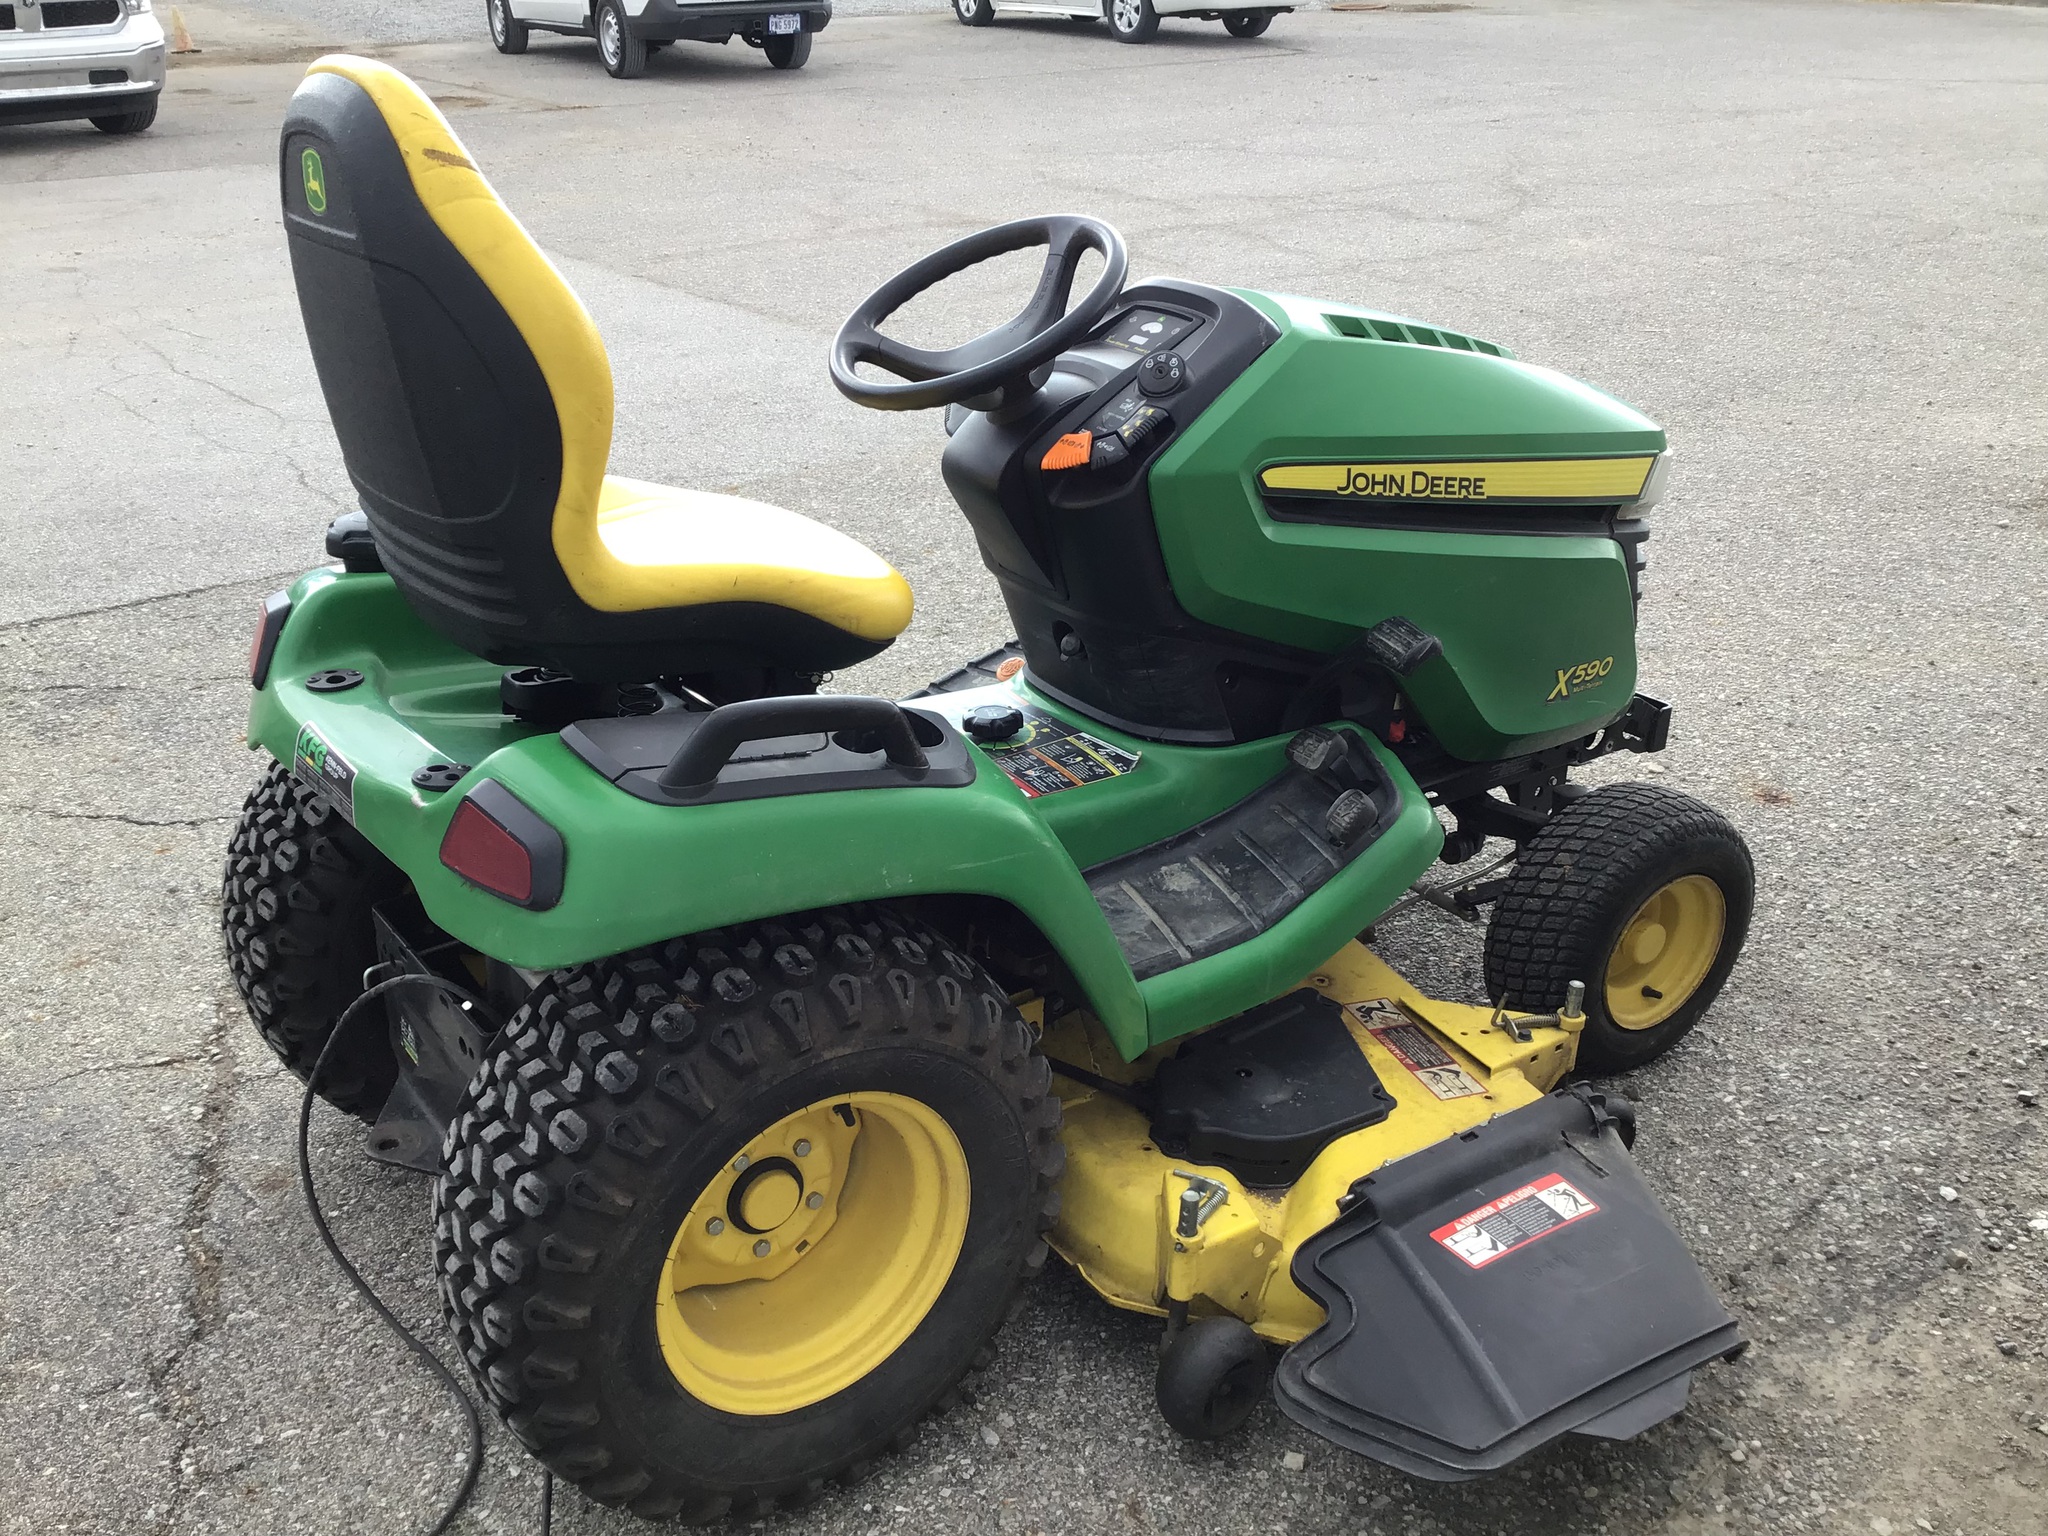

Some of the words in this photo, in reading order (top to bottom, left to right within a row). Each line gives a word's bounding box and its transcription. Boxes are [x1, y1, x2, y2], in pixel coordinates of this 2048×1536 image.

[1336, 467, 1405, 495] JOHN
[1411, 470, 1486, 498] DEERE
[1546, 655, 1614, 701] X590
[299, 728, 328, 767] KFG
[1376, 1033, 1406, 1060] DANGER
[1462, 1205, 1498, 1227] DANGER
[1502, 1185, 1538, 1208] PELIGRO
